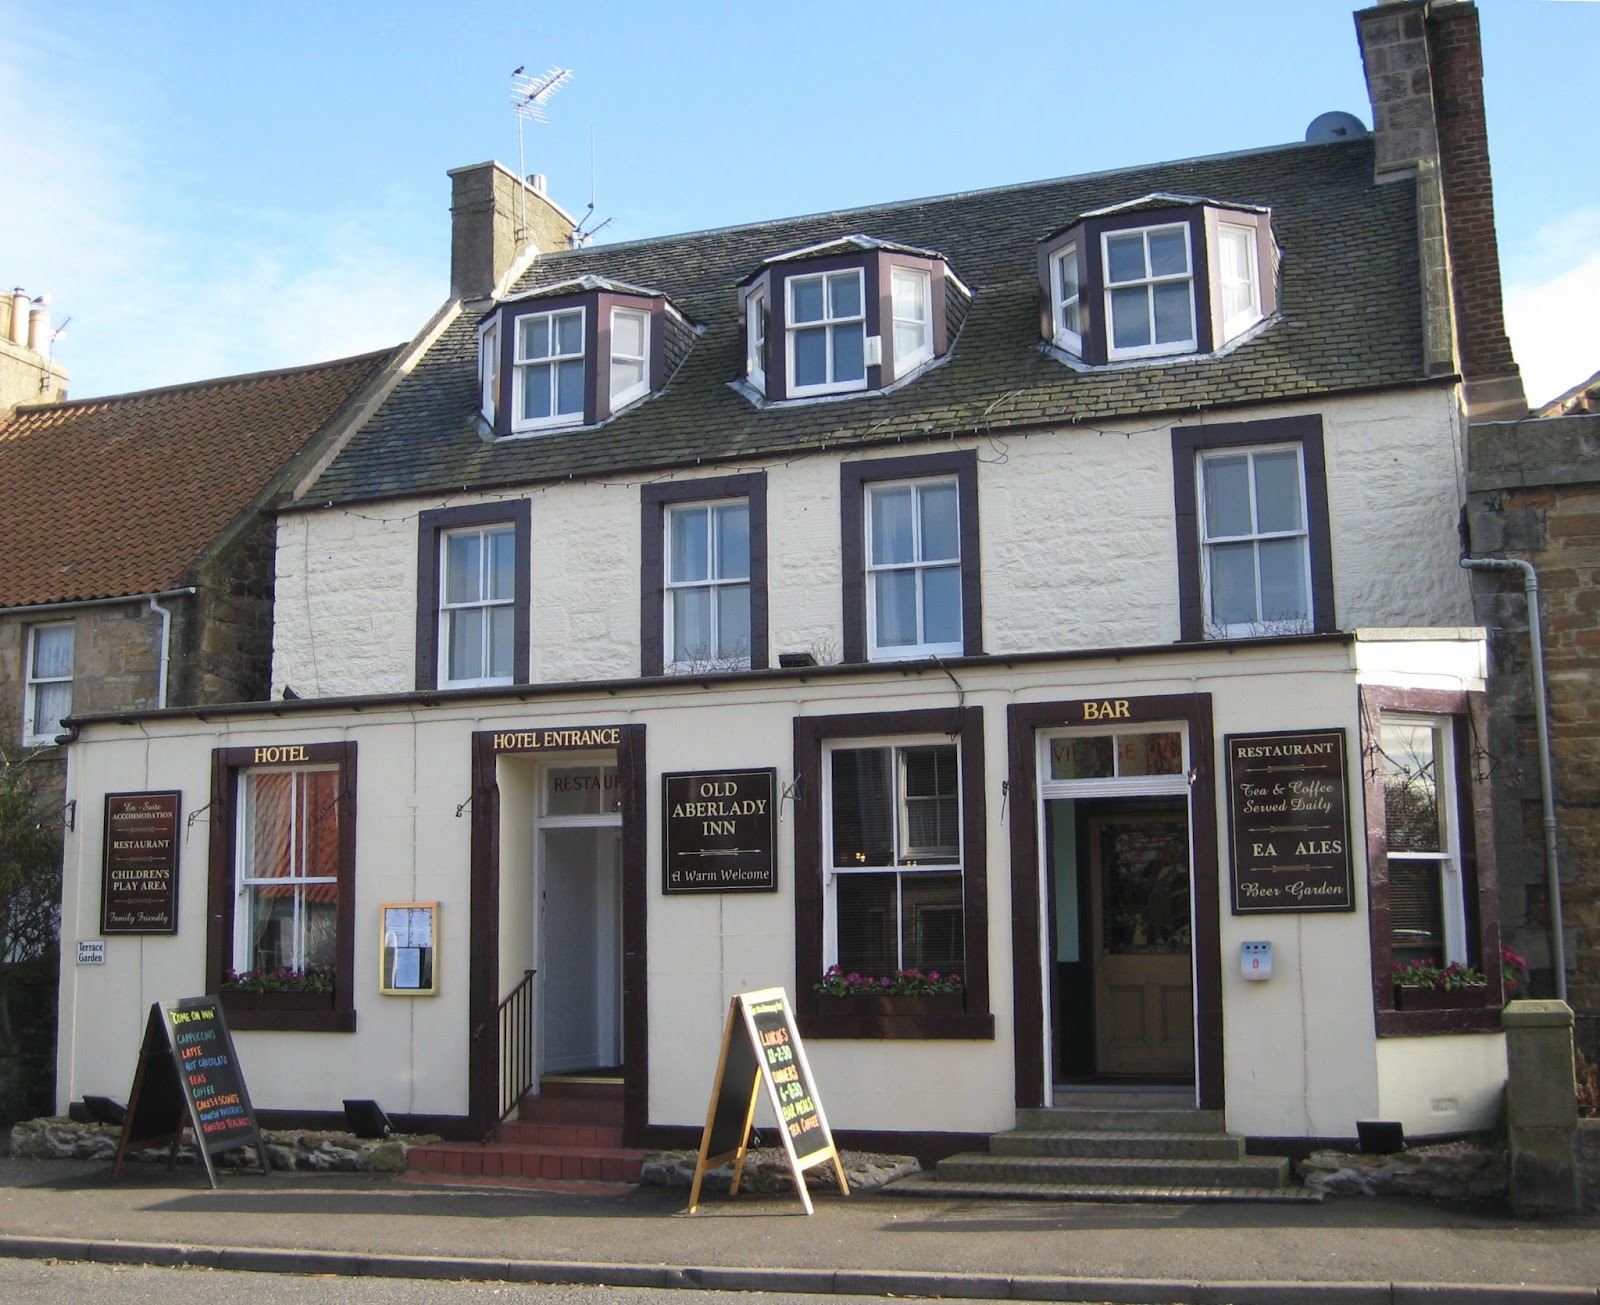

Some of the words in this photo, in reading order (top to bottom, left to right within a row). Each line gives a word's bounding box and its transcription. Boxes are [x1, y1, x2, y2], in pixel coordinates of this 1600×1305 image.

[1082, 699, 1131, 720] BAR
[493, 732, 541, 749] HOTEL
[544, 728, 620, 747] ENTRANCE
[254, 745, 310, 763] HOTEL
[1237, 742, 1334, 758] RESTAURANT
[700, 781, 738, 798] OLD
[1240, 782, 1268, 797] Tea
[1272, 782, 1286, 795] &
[1288, 780, 1334, 798] Coffee
[672, 799, 767, 818] ABERLADY
[1243, 799, 1287, 813] Served
[1290, 797, 1333, 814] Daily
[112, 811, 173, 820] ACCOMMODATION
[702, 820, 737, 836] INN
[113, 839, 171, 849] RESTAURANT
[1295, 840, 1342, 856] ALES
[111, 869, 170, 880] CHILDREN'S
[671, 870, 681, 882] A
[684, 869, 717, 881] Warm
[721, 868, 770, 880] Welcome
[113, 881, 141, 891] PLAY
[141, 881, 167, 891] AREA
[1240, 882, 1281, 897] Beer
[1284, 880, 1343, 900] Garden
[109, 911, 135, 925] Family
[137, 911, 168, 925] Friendly
[78, 942, 103, 951] Terrace
[78, 952, 103, 962] Garden
[191, 1010, 201, 1021] ON
[182, 1045, 203, 1059] LATTE
[185, 1060, 197, 1072] HOT
[198, 1055, 228, 1069] CHOCOLATE
[189, 1073, 207, 1085] TEAS
[193, 1085, 215, 1098] COFFEE
[782, 1102, 797, 1122] BAR
[796, 1095, 815, 1117] MEALS
[788, 1122, 802, 1138] TEA
